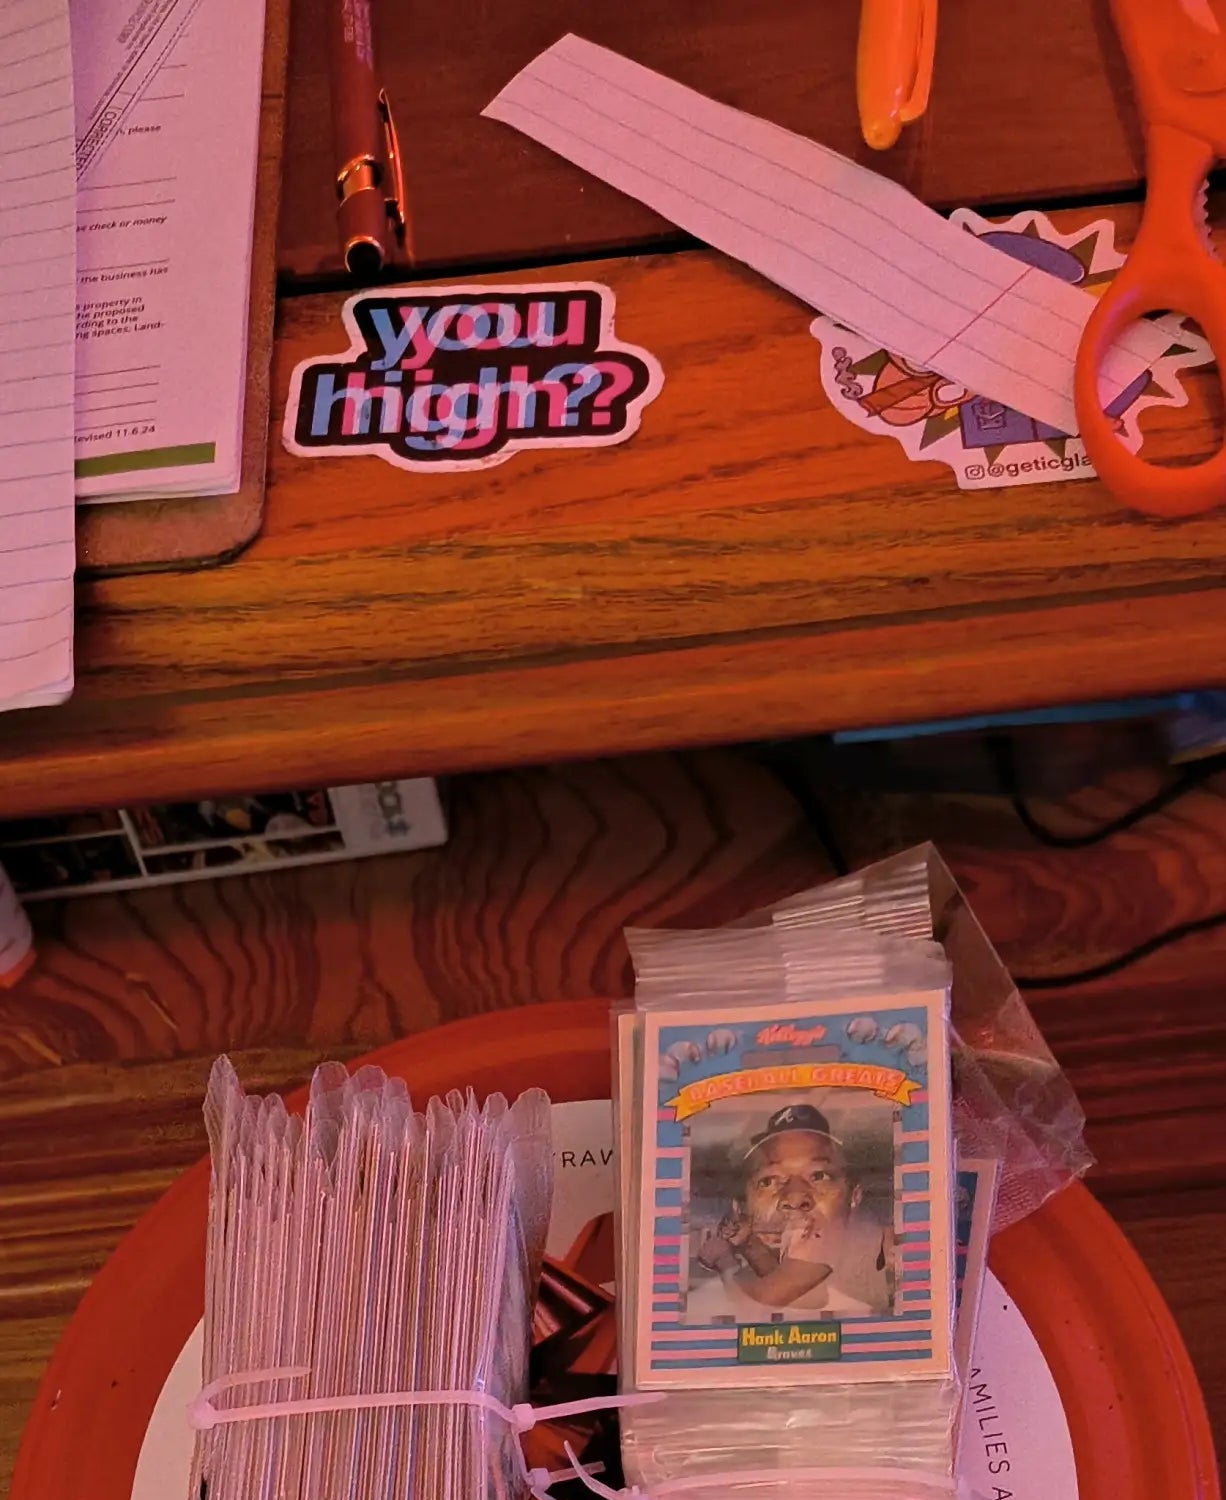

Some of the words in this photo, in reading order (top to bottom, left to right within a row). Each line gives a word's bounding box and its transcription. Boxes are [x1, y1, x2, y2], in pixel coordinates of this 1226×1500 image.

[128, 125, 161, 136] please
[88, 221, 116, 231] check
[119, 220, 131, 228] or
[132, 215, 168, 225] money
[81, 276, 98, 284] the
[100, 269, 147, 282] business
[83, 299, 129, 312] property
[92, 303, 145, 318] proposed
[76, 319, 105, 329] rding
[107, 318, 118, 326] to
[121, 315, 138, 324] the
[742, 1327, 784, 1346] Hank
[788, 1325, 837, 1344] Aaron
